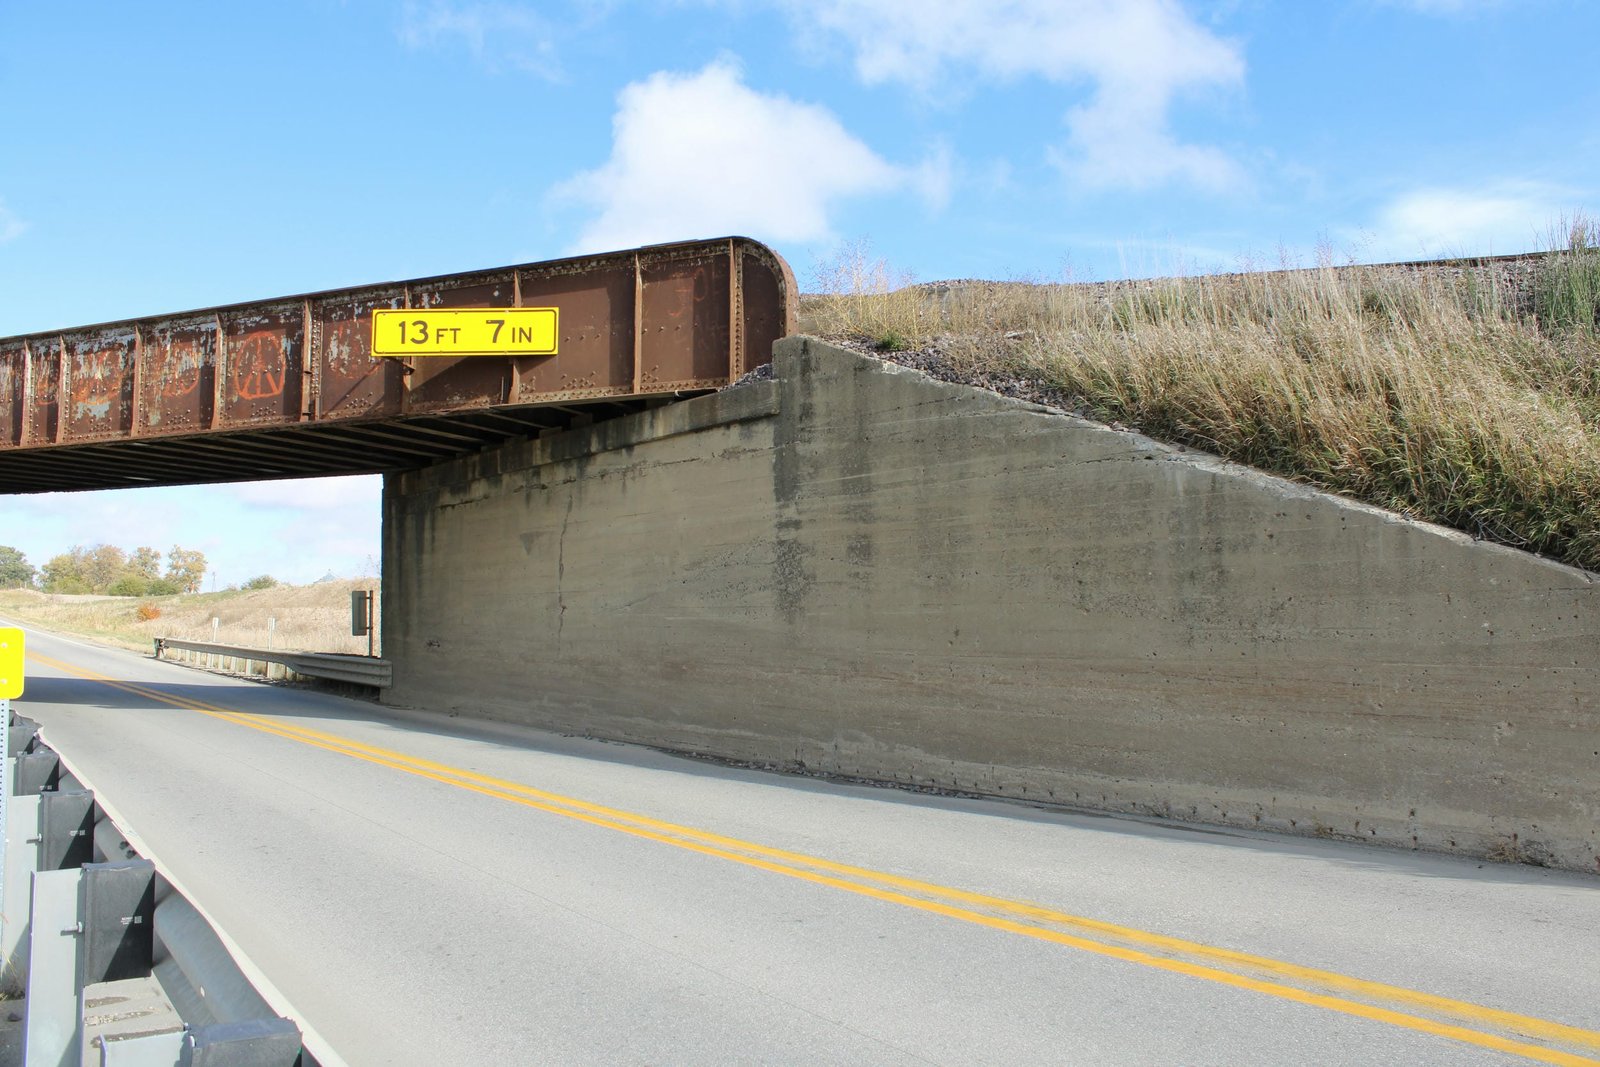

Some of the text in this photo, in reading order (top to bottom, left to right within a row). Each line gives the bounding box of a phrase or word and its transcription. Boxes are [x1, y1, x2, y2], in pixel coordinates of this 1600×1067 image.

[398, 319, 533, 345] 13 FT 7 IN
